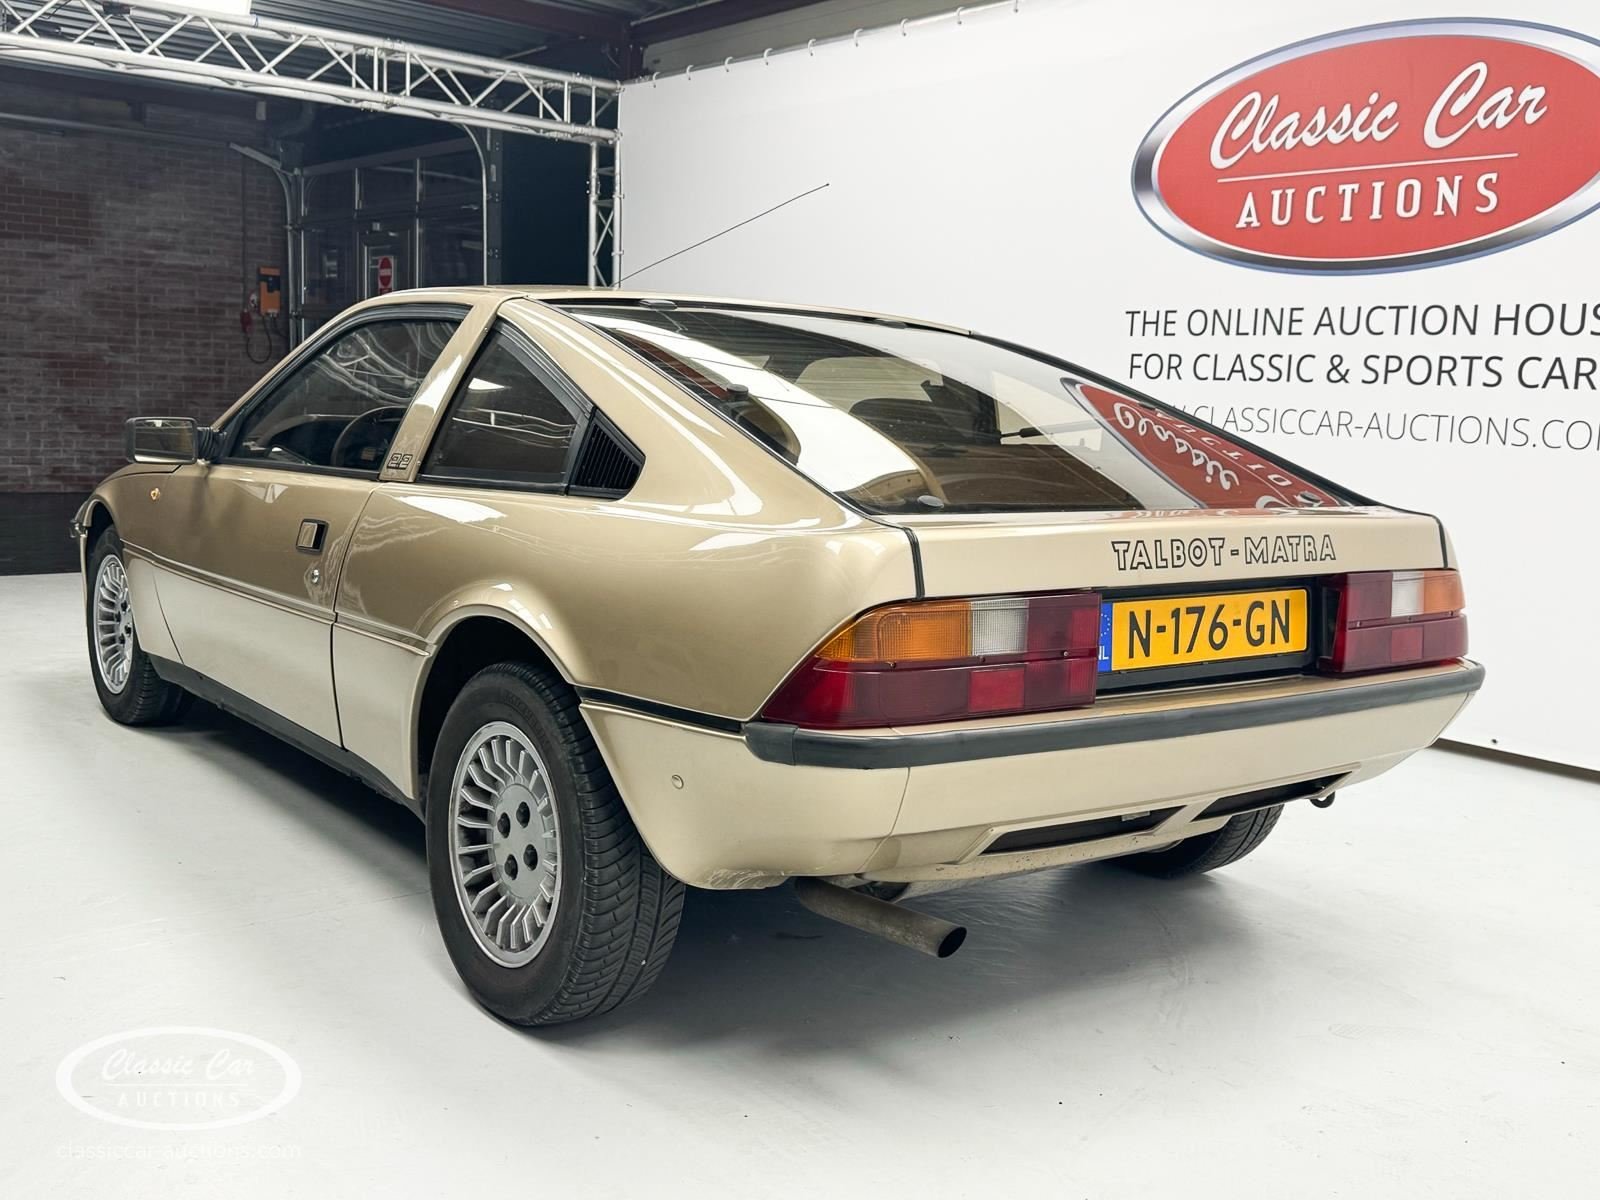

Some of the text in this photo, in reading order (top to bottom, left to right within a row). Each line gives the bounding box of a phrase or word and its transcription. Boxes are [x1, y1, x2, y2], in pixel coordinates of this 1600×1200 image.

[1209, 61, 1547, 169] Classic Car
[1235, 172, 1499, 229] AUCTIONS
[1125, 309, 1177, 337] THE
[1187, 307, 1304, 336] ONLINE
[1313, 304, 1479, 336] AUCTION
[1129, 353, 1597, 390] FOR CLASSIC & SPORTS CAR
[1127, 598, 1290, 659] N-176-GN
